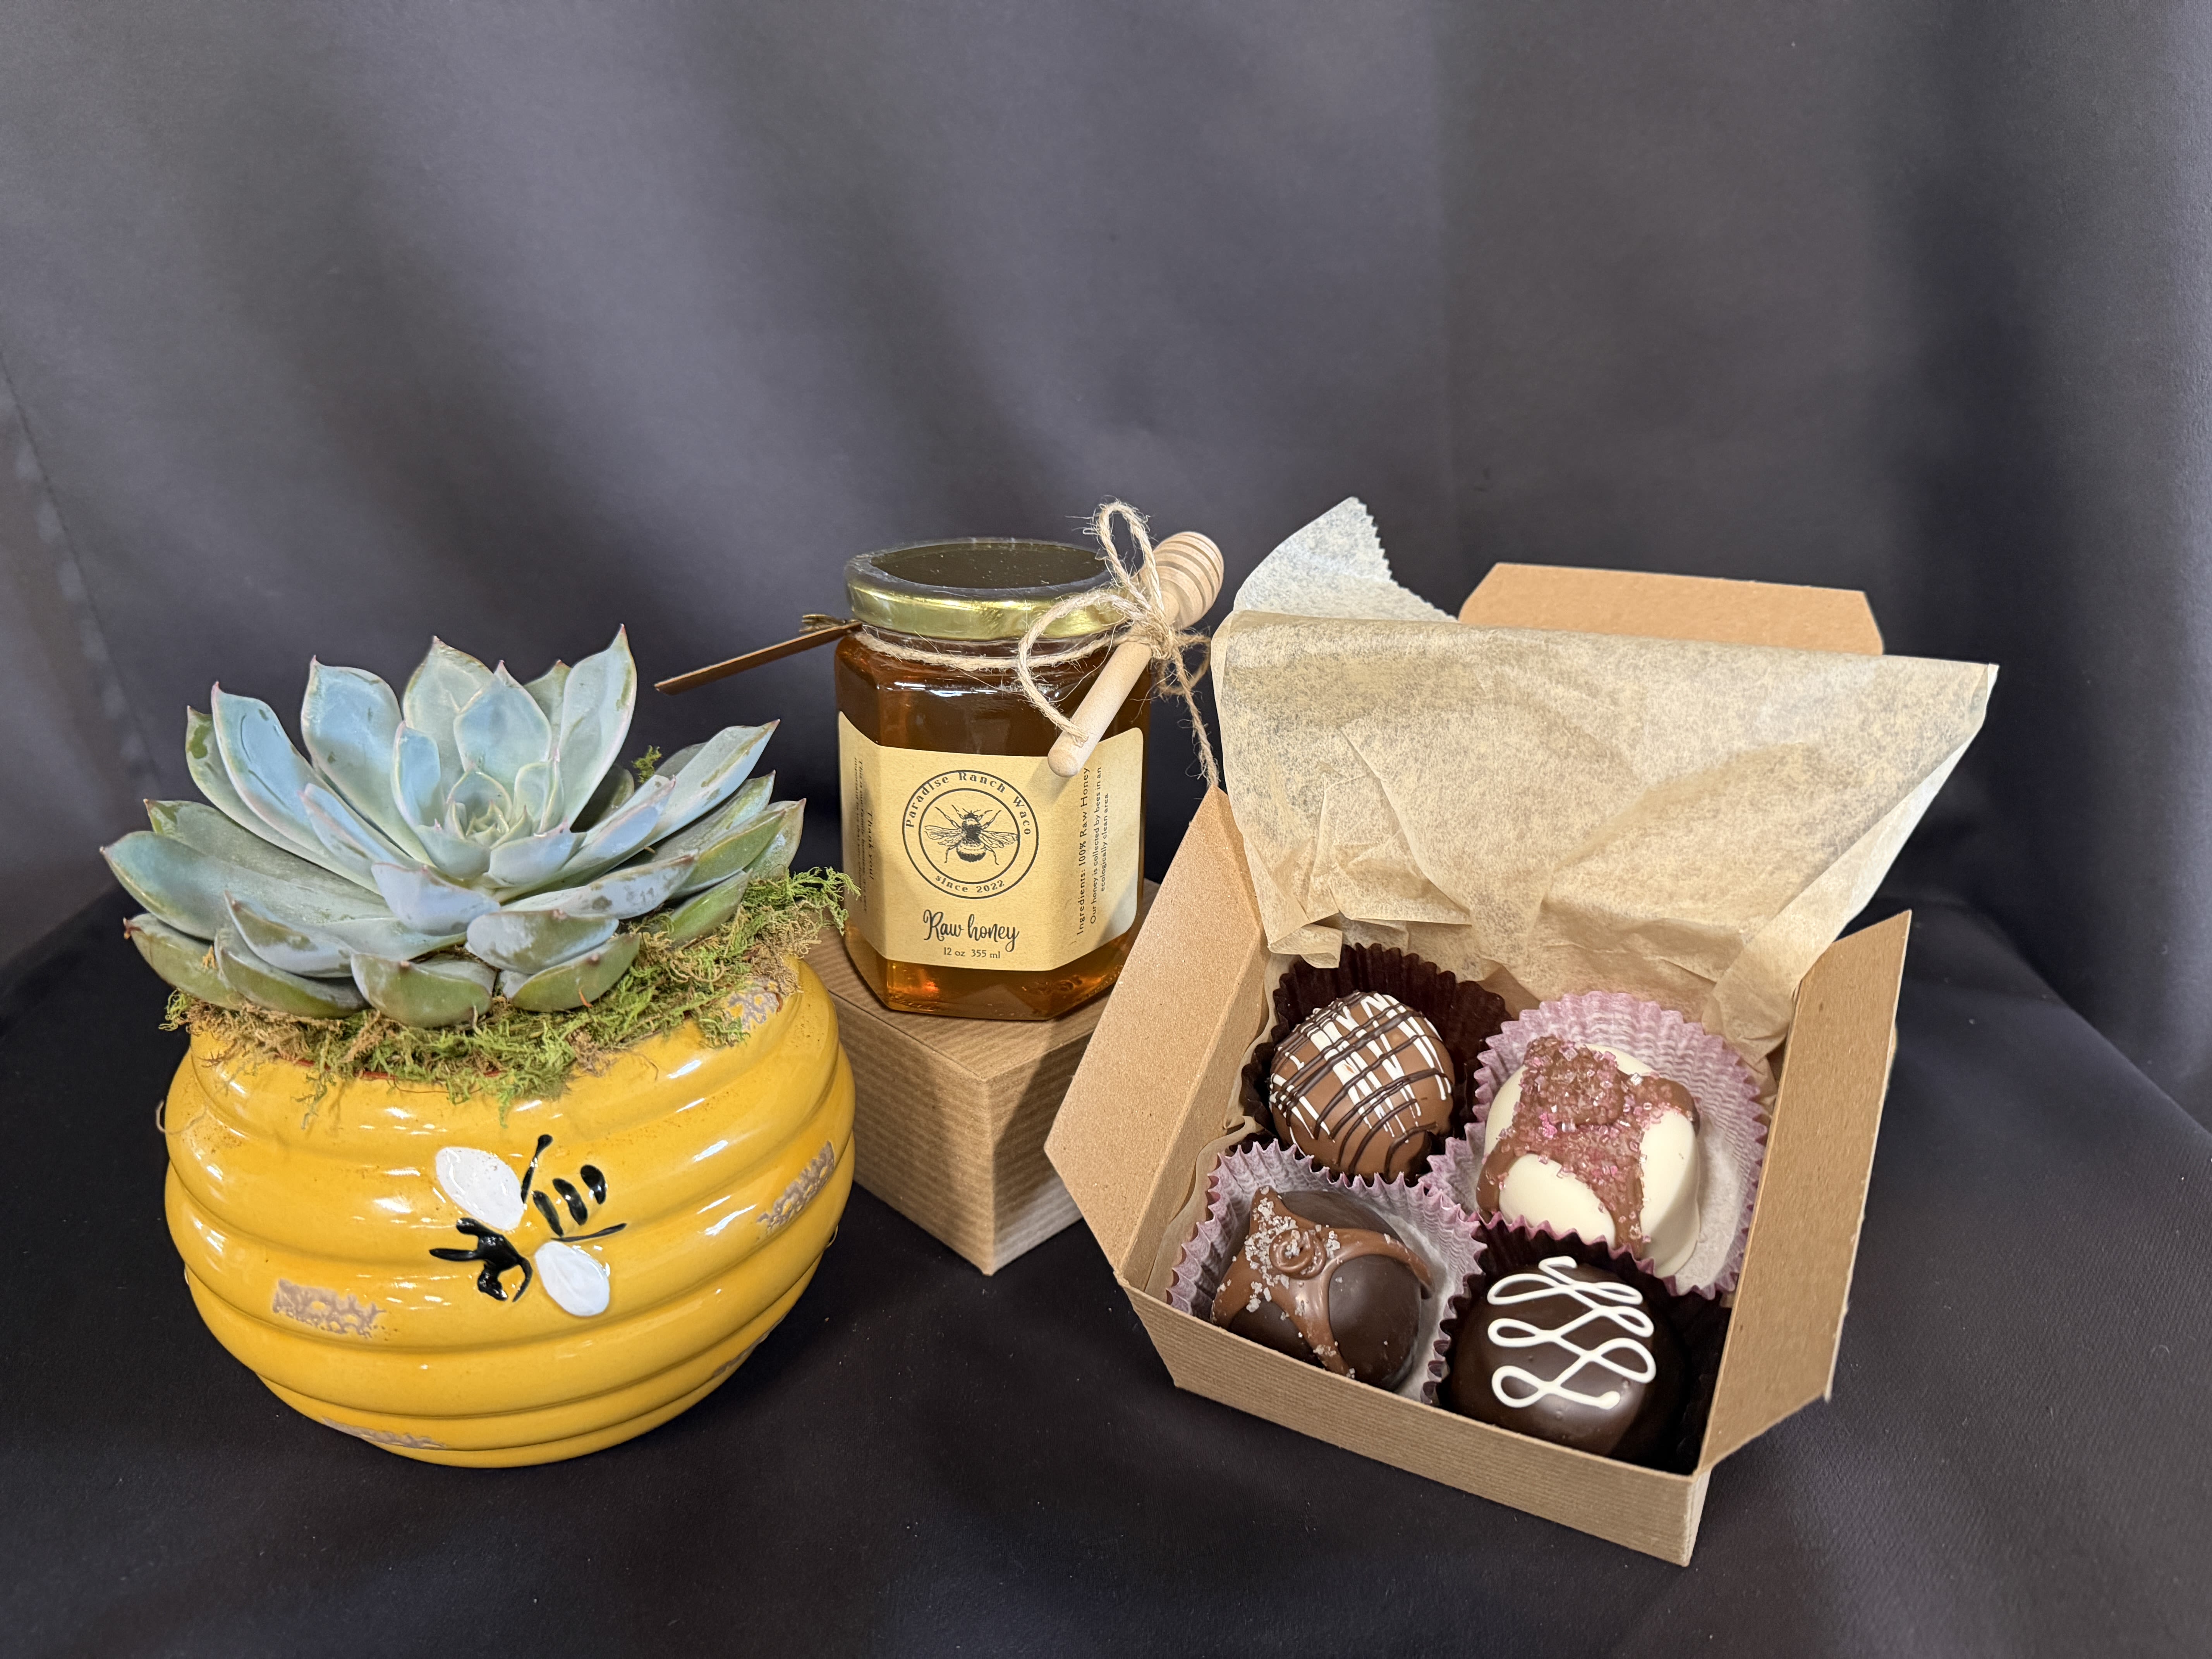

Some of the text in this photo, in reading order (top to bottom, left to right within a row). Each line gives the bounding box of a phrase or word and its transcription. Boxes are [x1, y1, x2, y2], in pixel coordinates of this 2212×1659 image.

[1095, 781, 1101, 790] in
[1097, 767, 1101, 779] an
[1080, 768, 1090, 807] Honey
[906, 771, 1031, 835] Paradise Ranch Waco
[1094, 815, 1101, 826] by
[1100, 842, 1108, 891] ecologically
[935, 875, 1005, 893] since 2022
[1077, 869, 1085, 935] Ingredients:
[923, 909, 1020, 952] Raw honey
[943, 947, 952, 955] 12
[971, 949, 986, 958] 355
[989, 951, 1000, 959] ml
